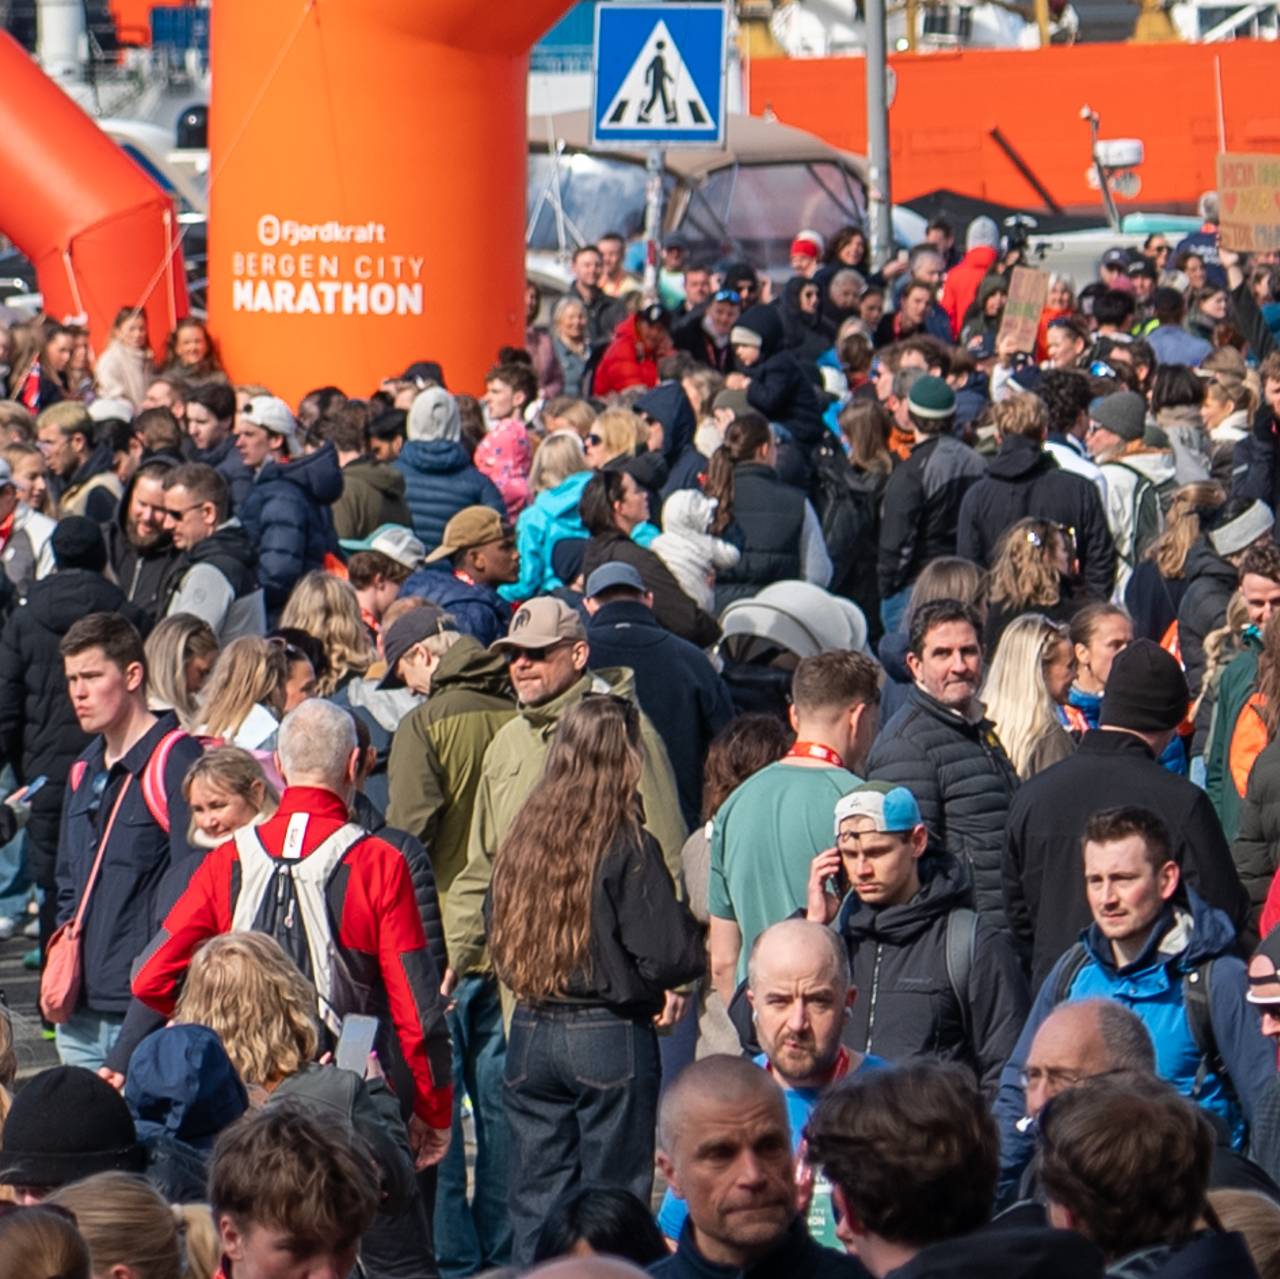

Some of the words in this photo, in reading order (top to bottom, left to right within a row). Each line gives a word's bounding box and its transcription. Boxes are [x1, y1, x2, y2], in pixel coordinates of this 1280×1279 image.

[281, 220, 386, 247] Fjordkraft
[232, 252, 339, 279] BERGEN
[354, 255, 425, 280] CITY
[232, 280, 424, 315] MARATHON
